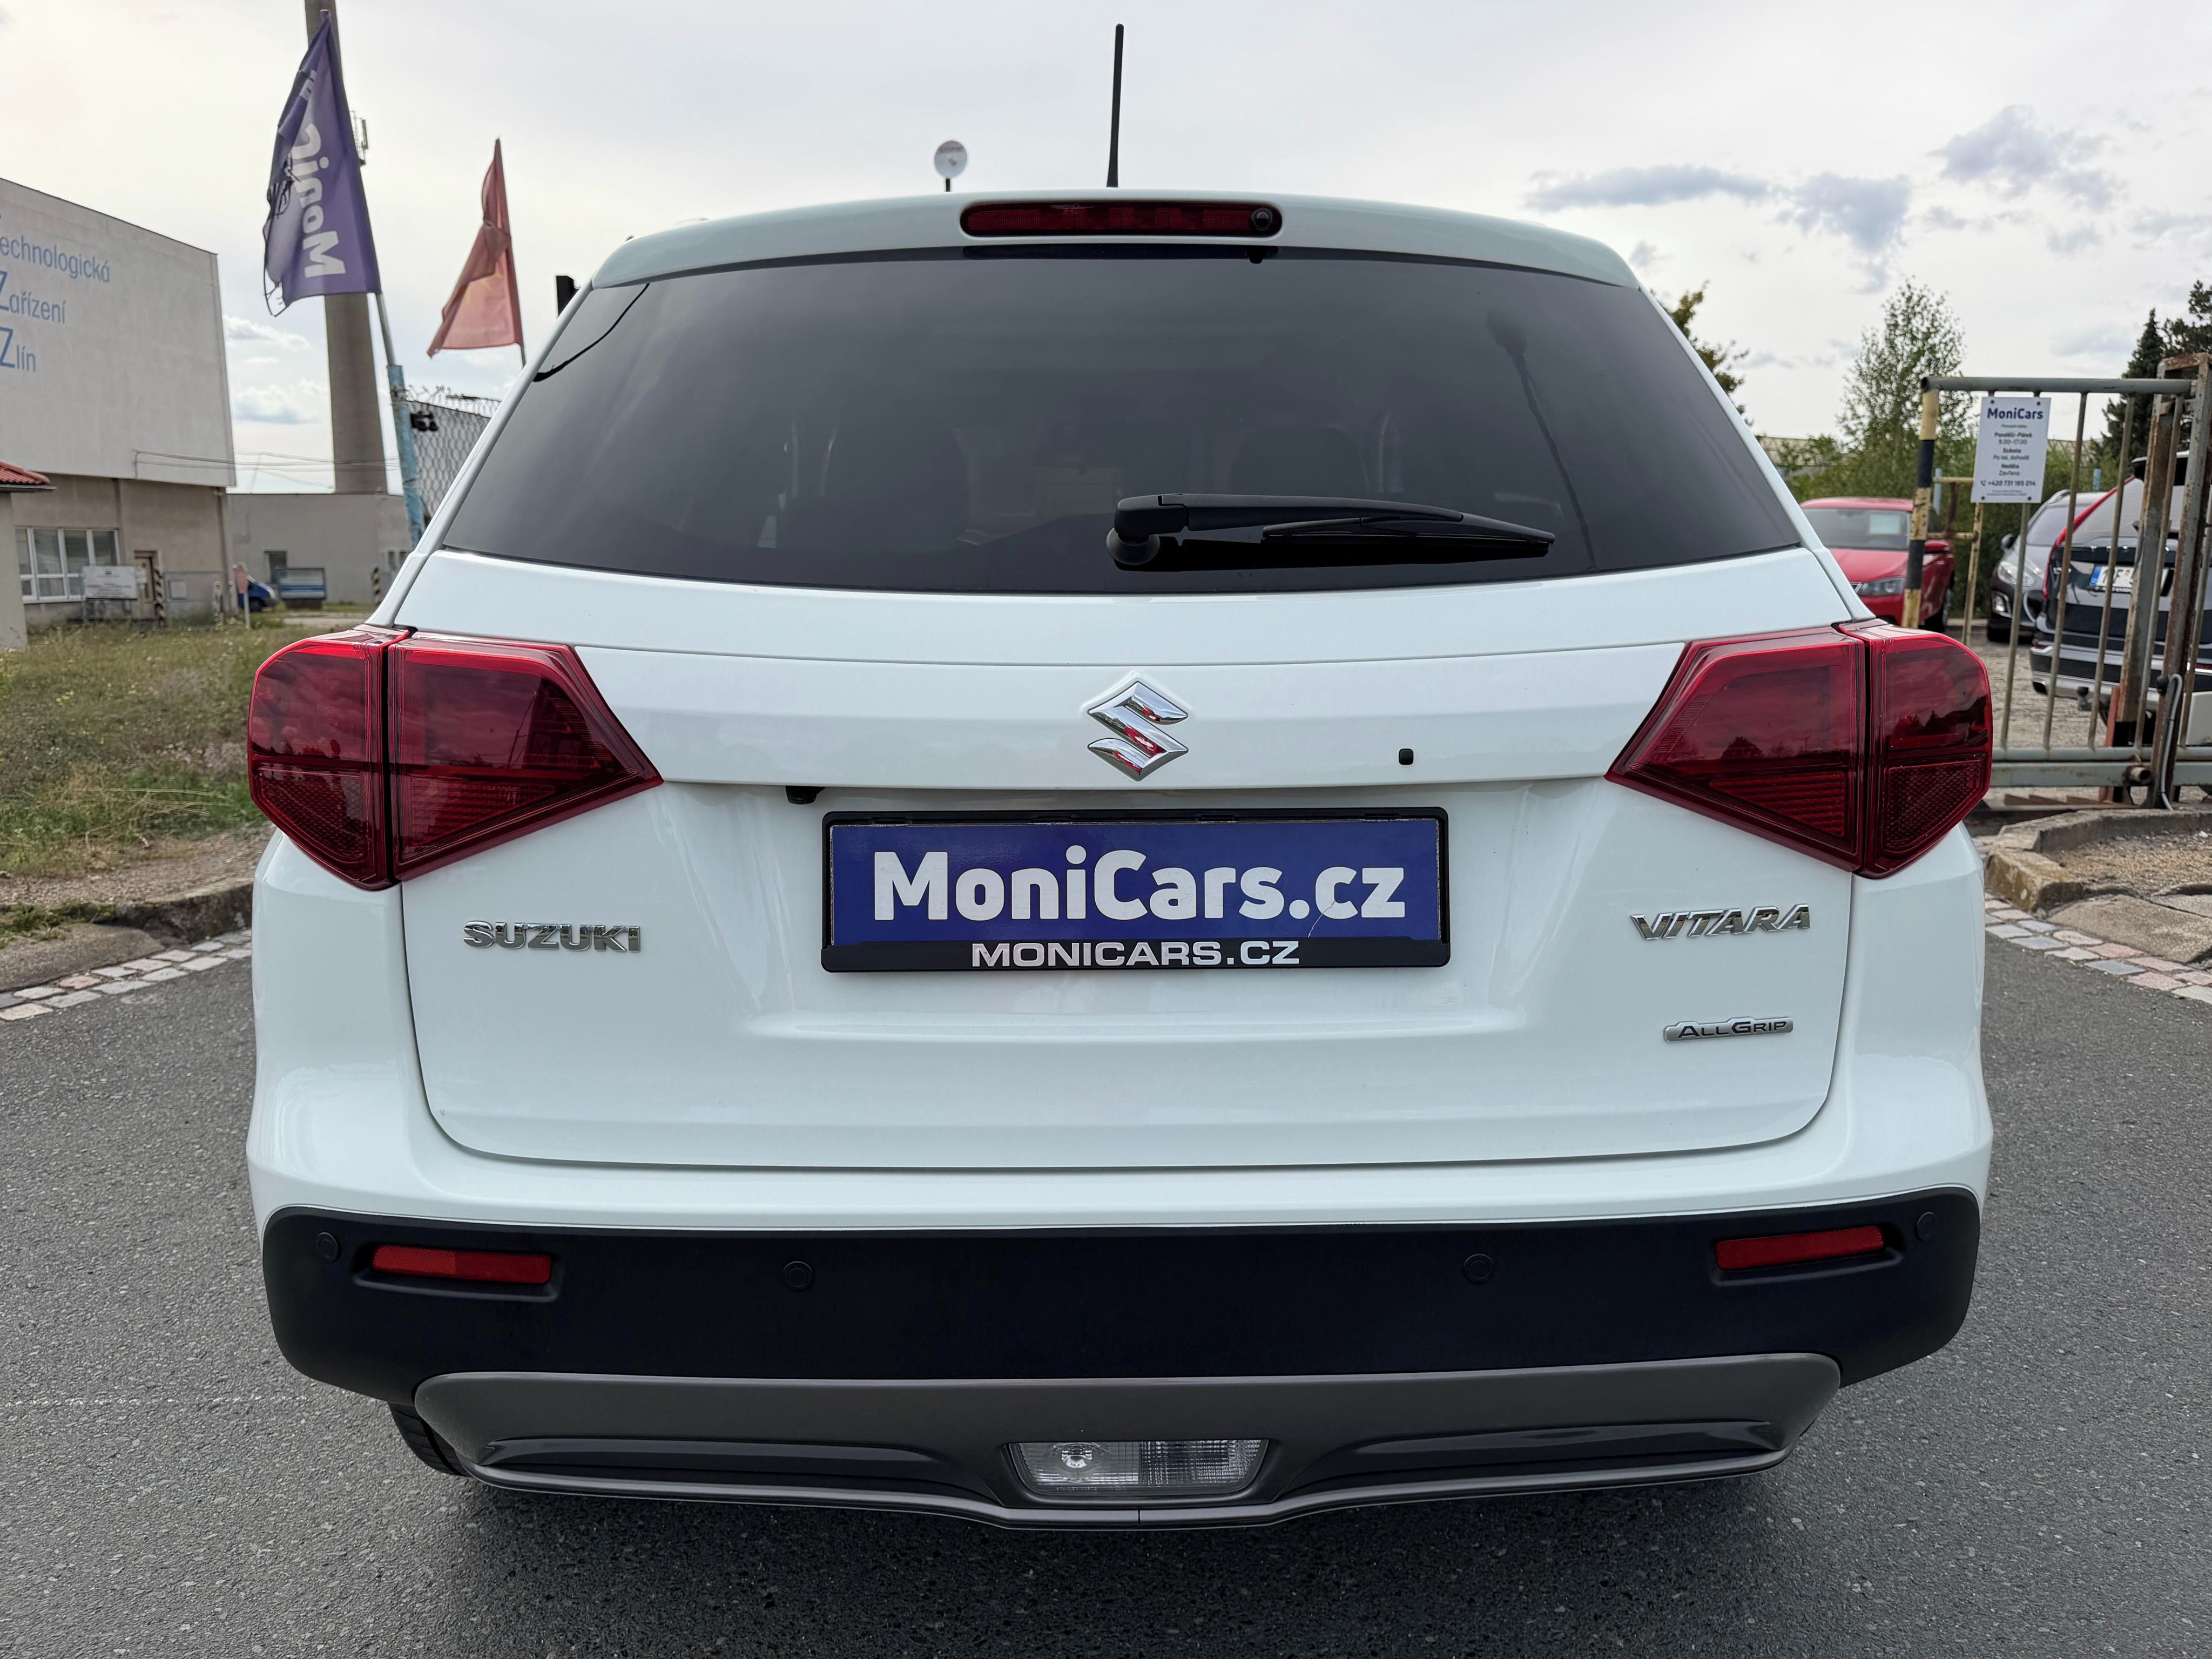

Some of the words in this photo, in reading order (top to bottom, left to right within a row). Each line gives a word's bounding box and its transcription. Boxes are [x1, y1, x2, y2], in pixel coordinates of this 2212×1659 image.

[0, 327, 36, 372] Zlín
[1987, 407, 2043, 419] MoniCars
[874, 845, 1406, 921] MoniCars.cz
[463, 920, 640, 953] SUZUKI
[1630, 903, 1811, 940] VITARA
[972, 941, 1300, 967] MONICARS.CZ
